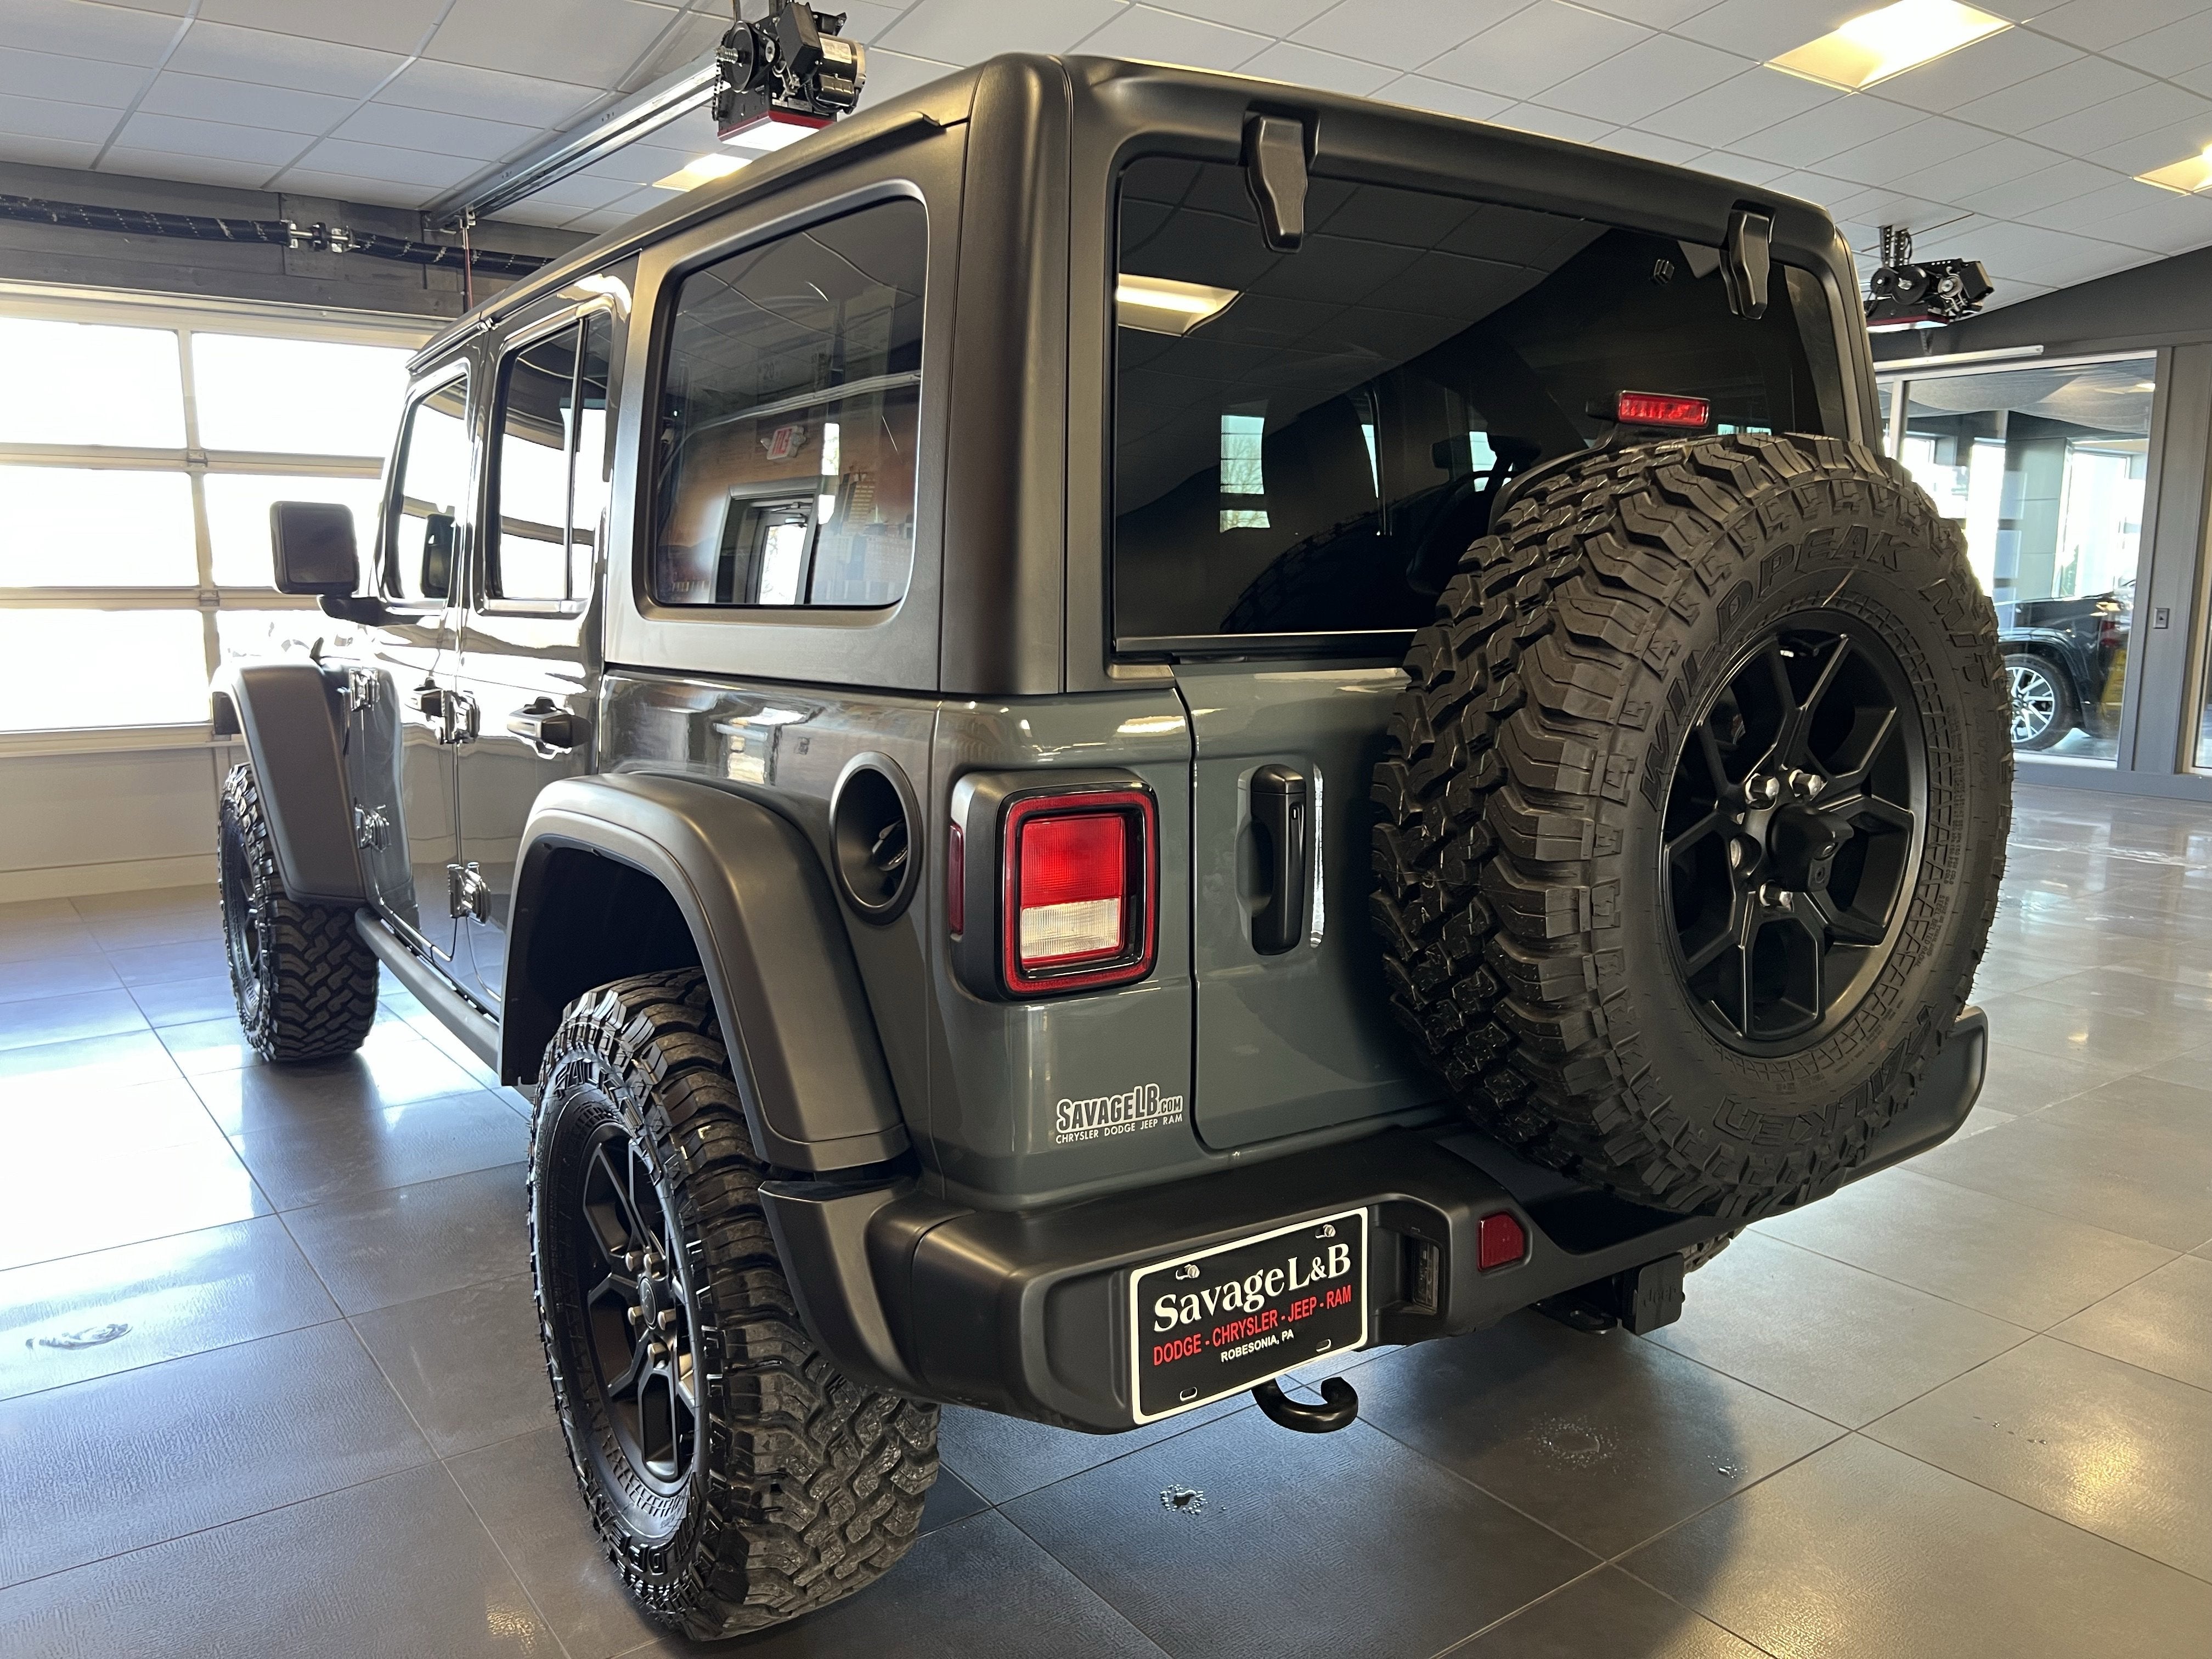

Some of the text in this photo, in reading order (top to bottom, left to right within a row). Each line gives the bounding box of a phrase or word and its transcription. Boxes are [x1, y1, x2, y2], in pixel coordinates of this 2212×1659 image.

[1056, 1113, 1183, 1144] CHRYSLER DODGE JEEP RAM
[1154, 1333, 1202, 1365] DODGE
[1212, 1309, 1278, 1347] CHRYSLER
[1288, 1297, 1317, 1323] JEEP
[1327, 1285, 1351, 1308] RAM
[1221, 1329, 1294, 1363] ROBESONIA, PA
